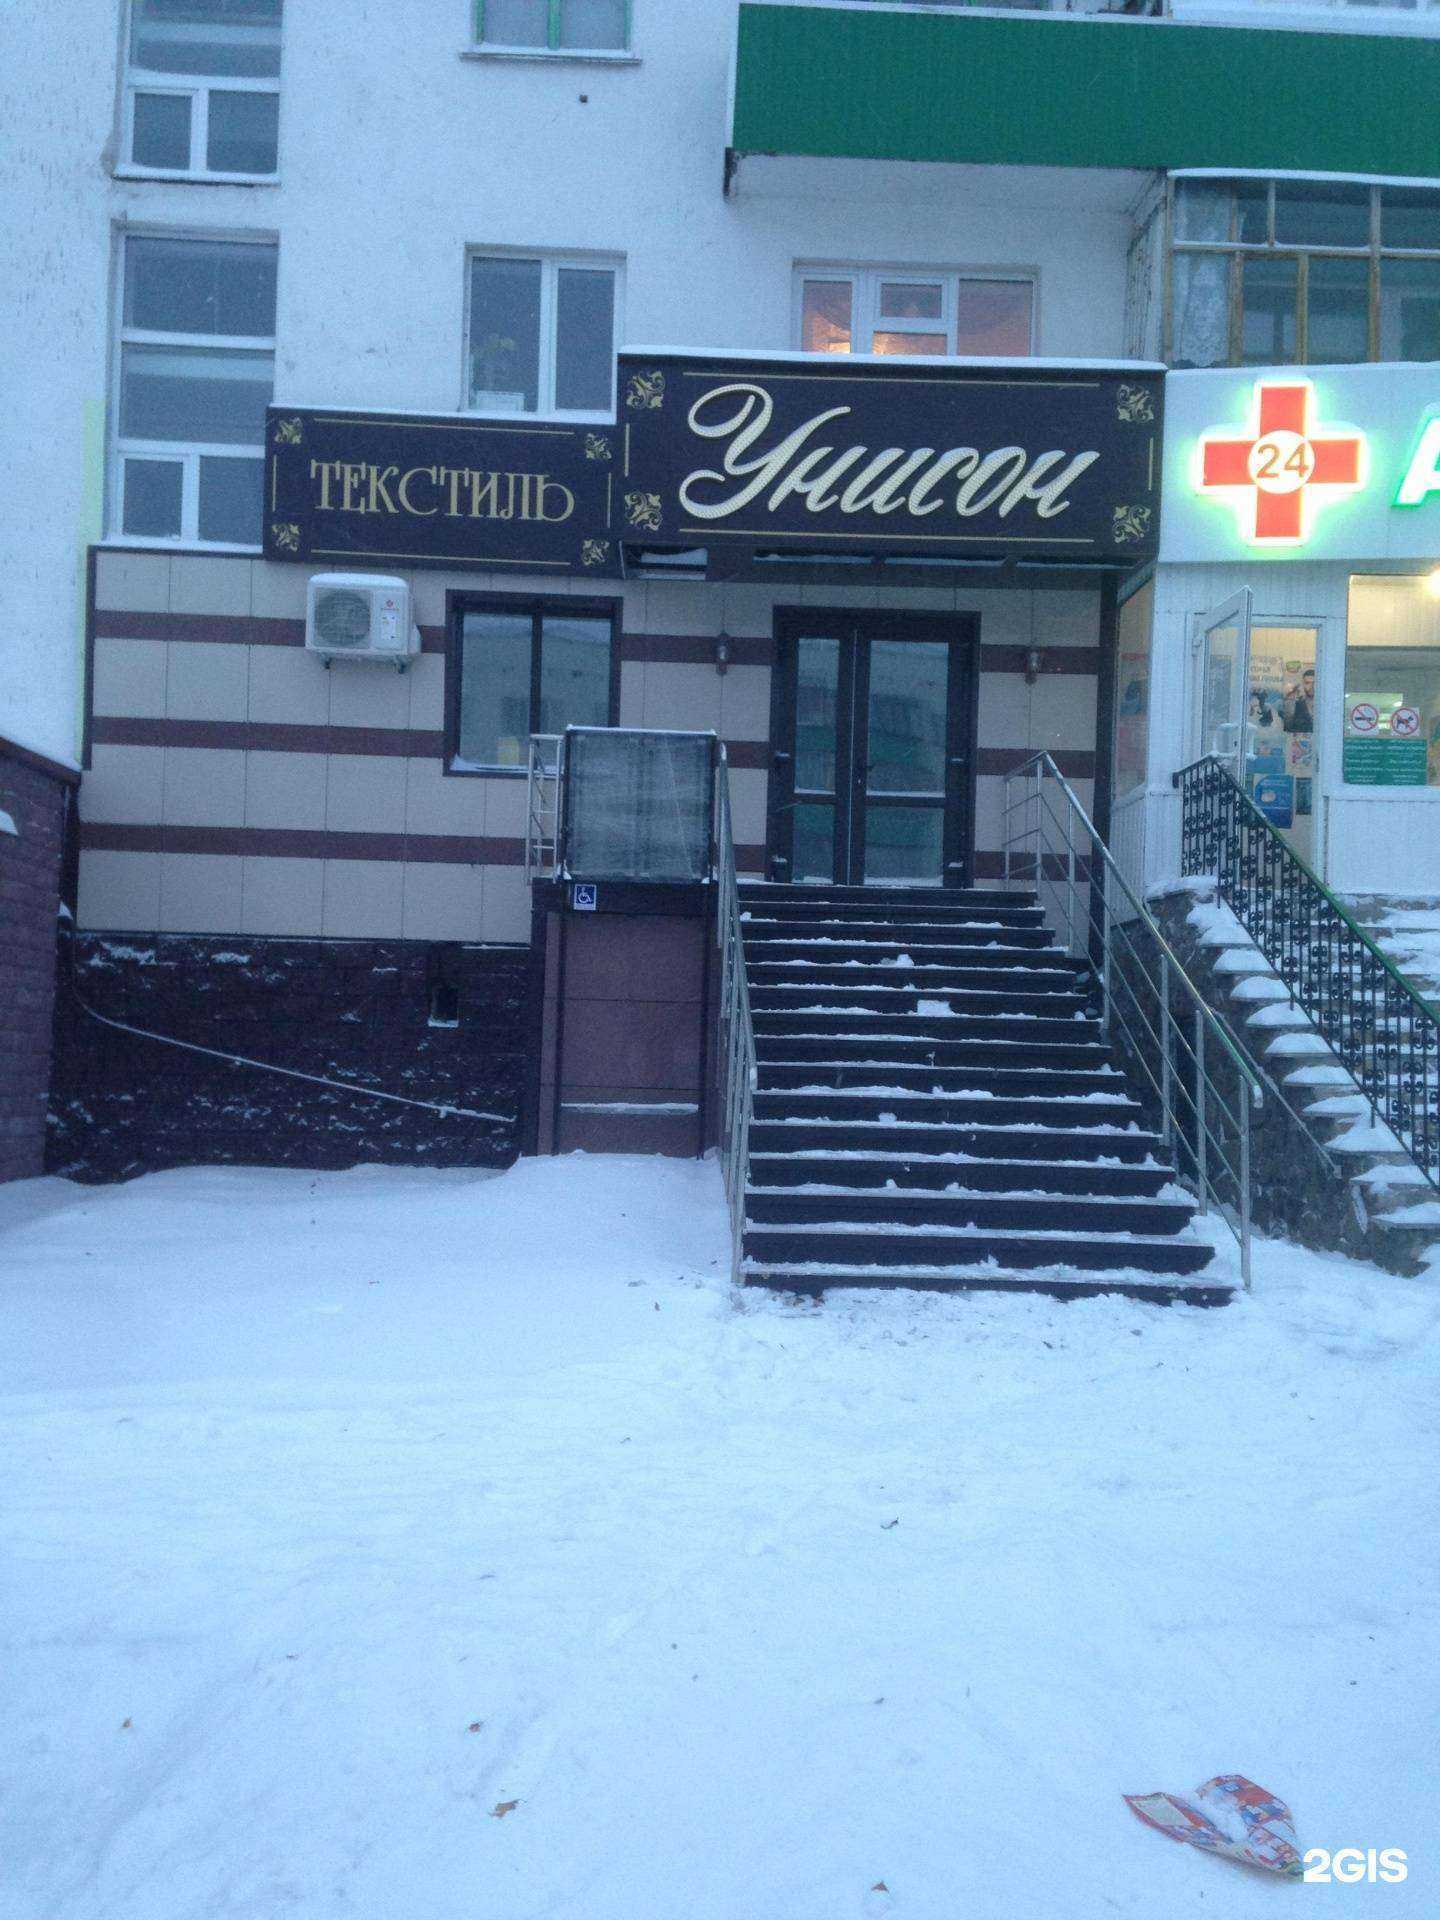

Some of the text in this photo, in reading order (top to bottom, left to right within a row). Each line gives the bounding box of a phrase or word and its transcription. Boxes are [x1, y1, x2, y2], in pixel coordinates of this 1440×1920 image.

[679, 383, 1100, 520] Унисон
[1256, 443, 1309, 479] 24
[310, 459, 576, 523] ТЕКСТИЛЬ
